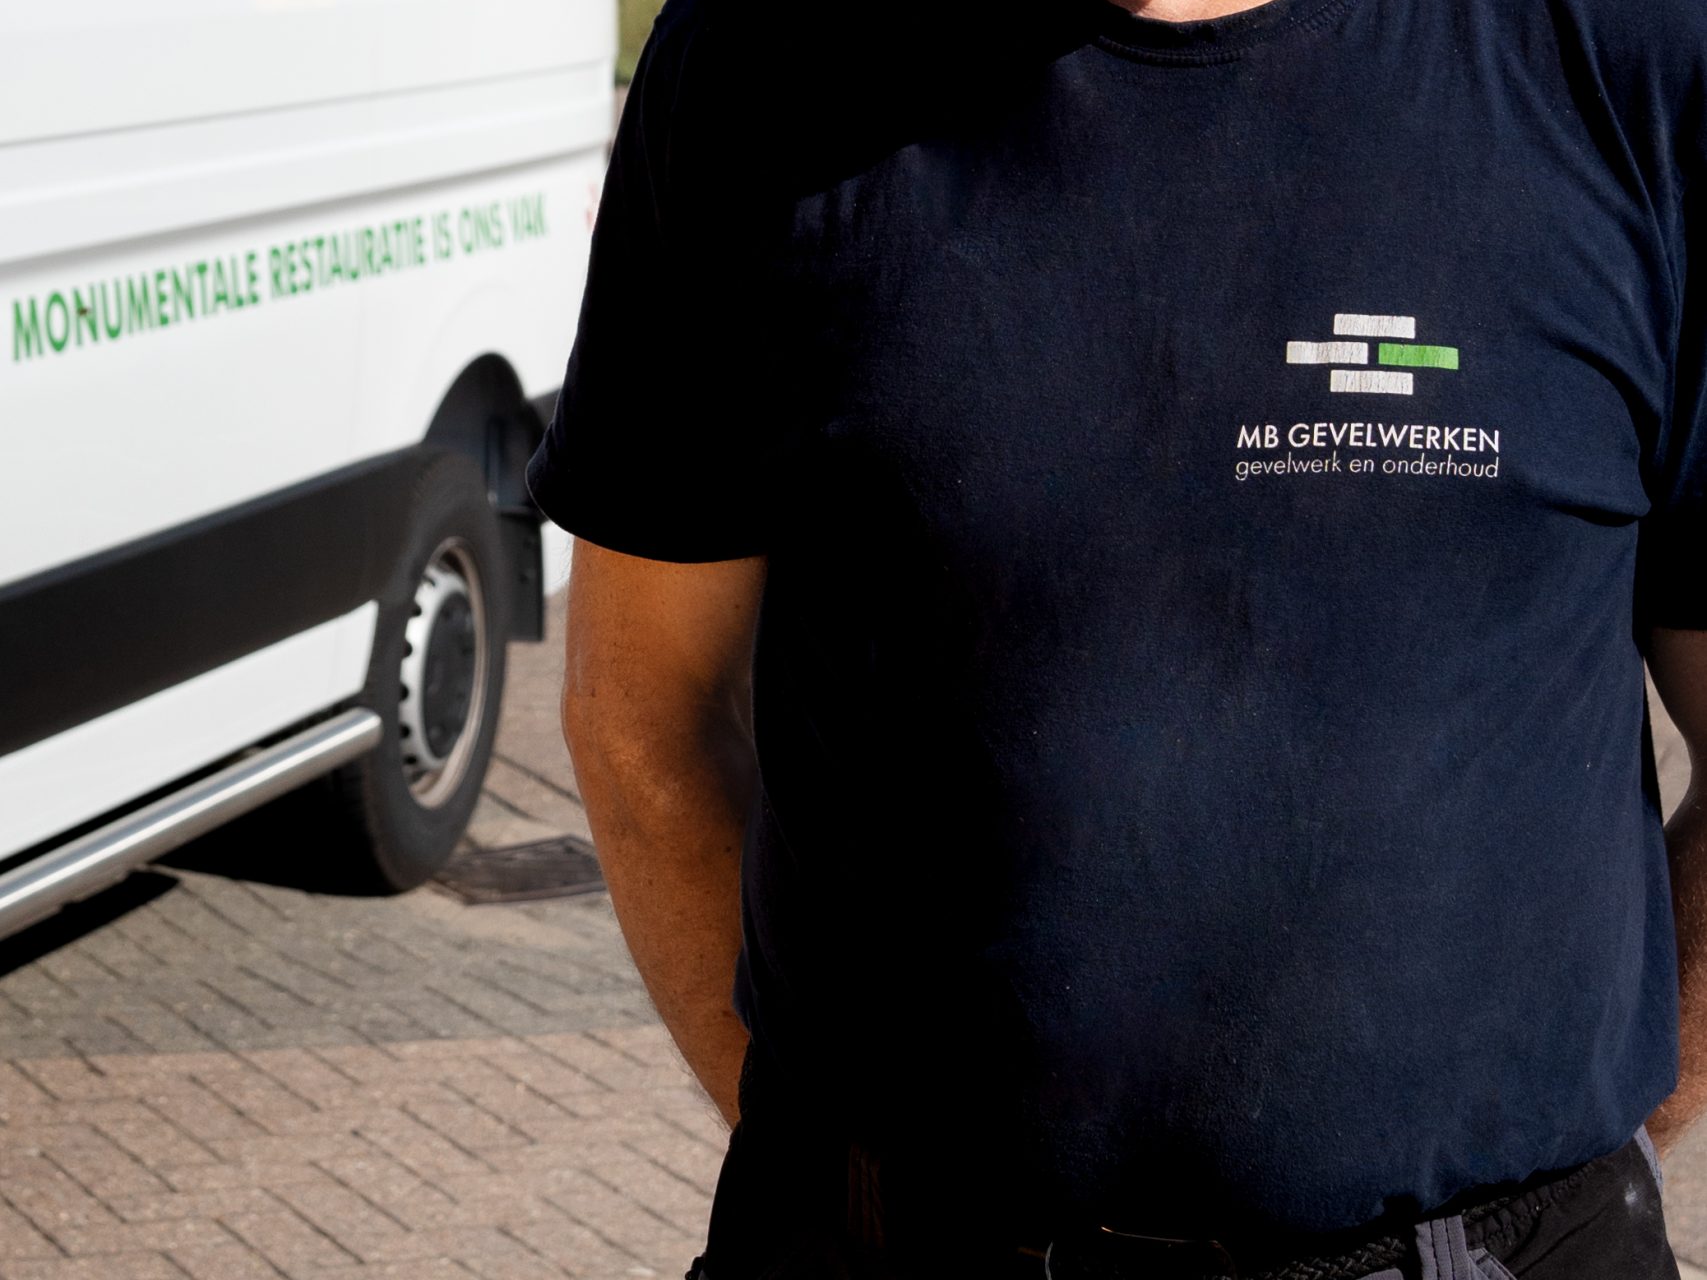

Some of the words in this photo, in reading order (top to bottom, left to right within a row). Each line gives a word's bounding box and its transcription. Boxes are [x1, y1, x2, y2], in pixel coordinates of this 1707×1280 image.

[12, 252, 260, 362] MONUMENTALE
[269, 211, 426, 301] RESTAURATIE
[433, 204, 453, 260] IS
[459, 199, 503, 255] ONS
[1236, 425, 1279, 449] MB
[1288, 422, 1500, 453] GEVELWERKEN
[1235, 451, 1342, 481] gevelwerk
[1349, 458, 1375, 473] en
[1382, 453, 1500, 478] onderhoud
